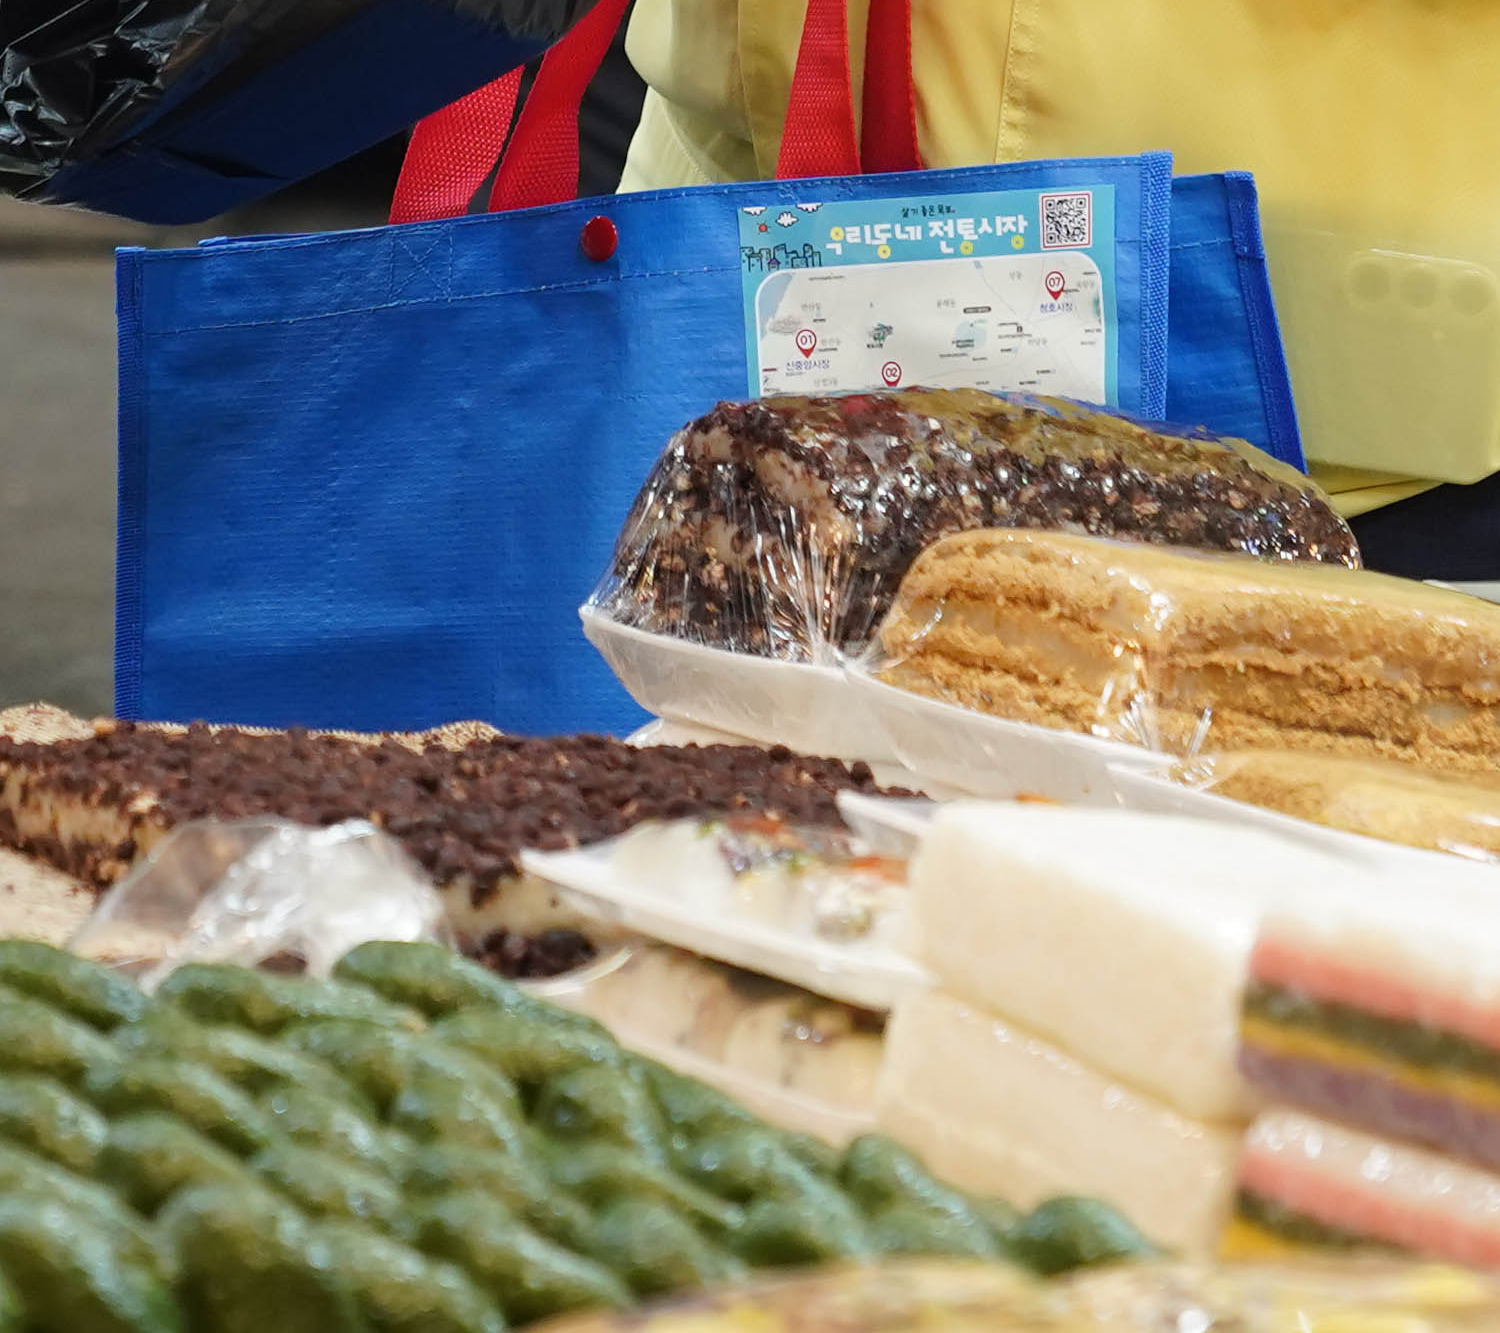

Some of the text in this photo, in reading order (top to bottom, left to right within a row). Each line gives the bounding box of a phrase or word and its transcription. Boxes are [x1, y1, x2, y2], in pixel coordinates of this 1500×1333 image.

[825, 214, 1029, 260] 우리동네 전통시장
[1048, 276, 1061, 288] 07
[800, 334, 813, 345] 01
[885, 367, 898, 378] 02
